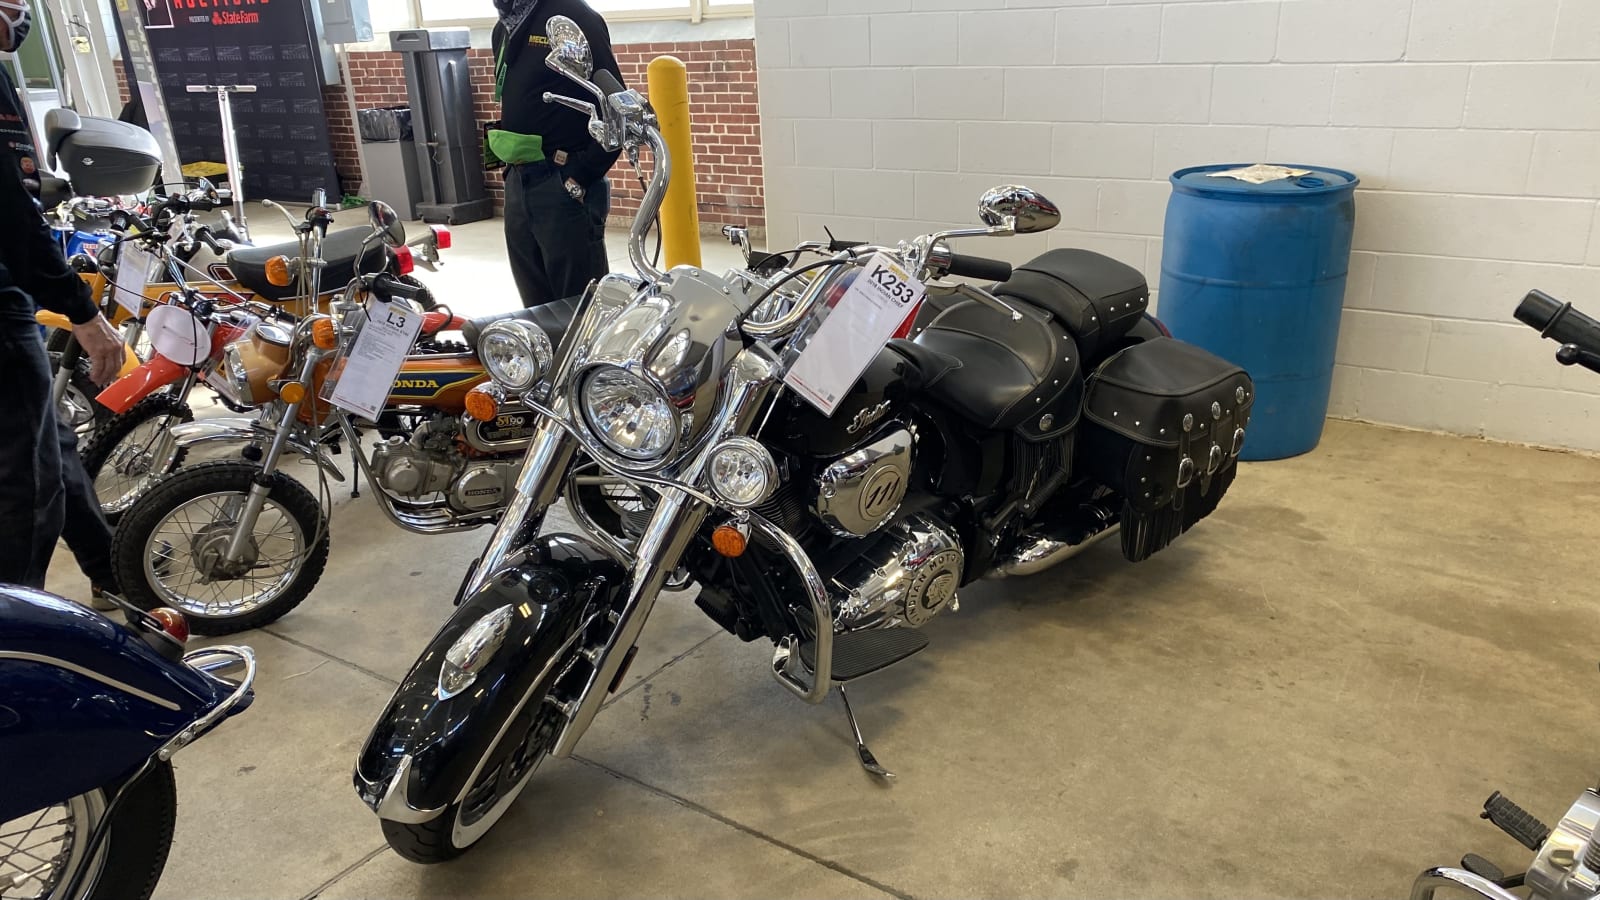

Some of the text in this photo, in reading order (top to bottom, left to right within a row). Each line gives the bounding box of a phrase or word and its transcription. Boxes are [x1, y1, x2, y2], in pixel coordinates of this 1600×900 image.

[529, 35, 549, 44] MECU
[871, 265, 913, 303] K253
[386, 312, 406, 328] L3
[393, 380, 439, 388] ONDA
[866, 476, 901, 509] 111
[908, 573, 928, 621] INDIAN
